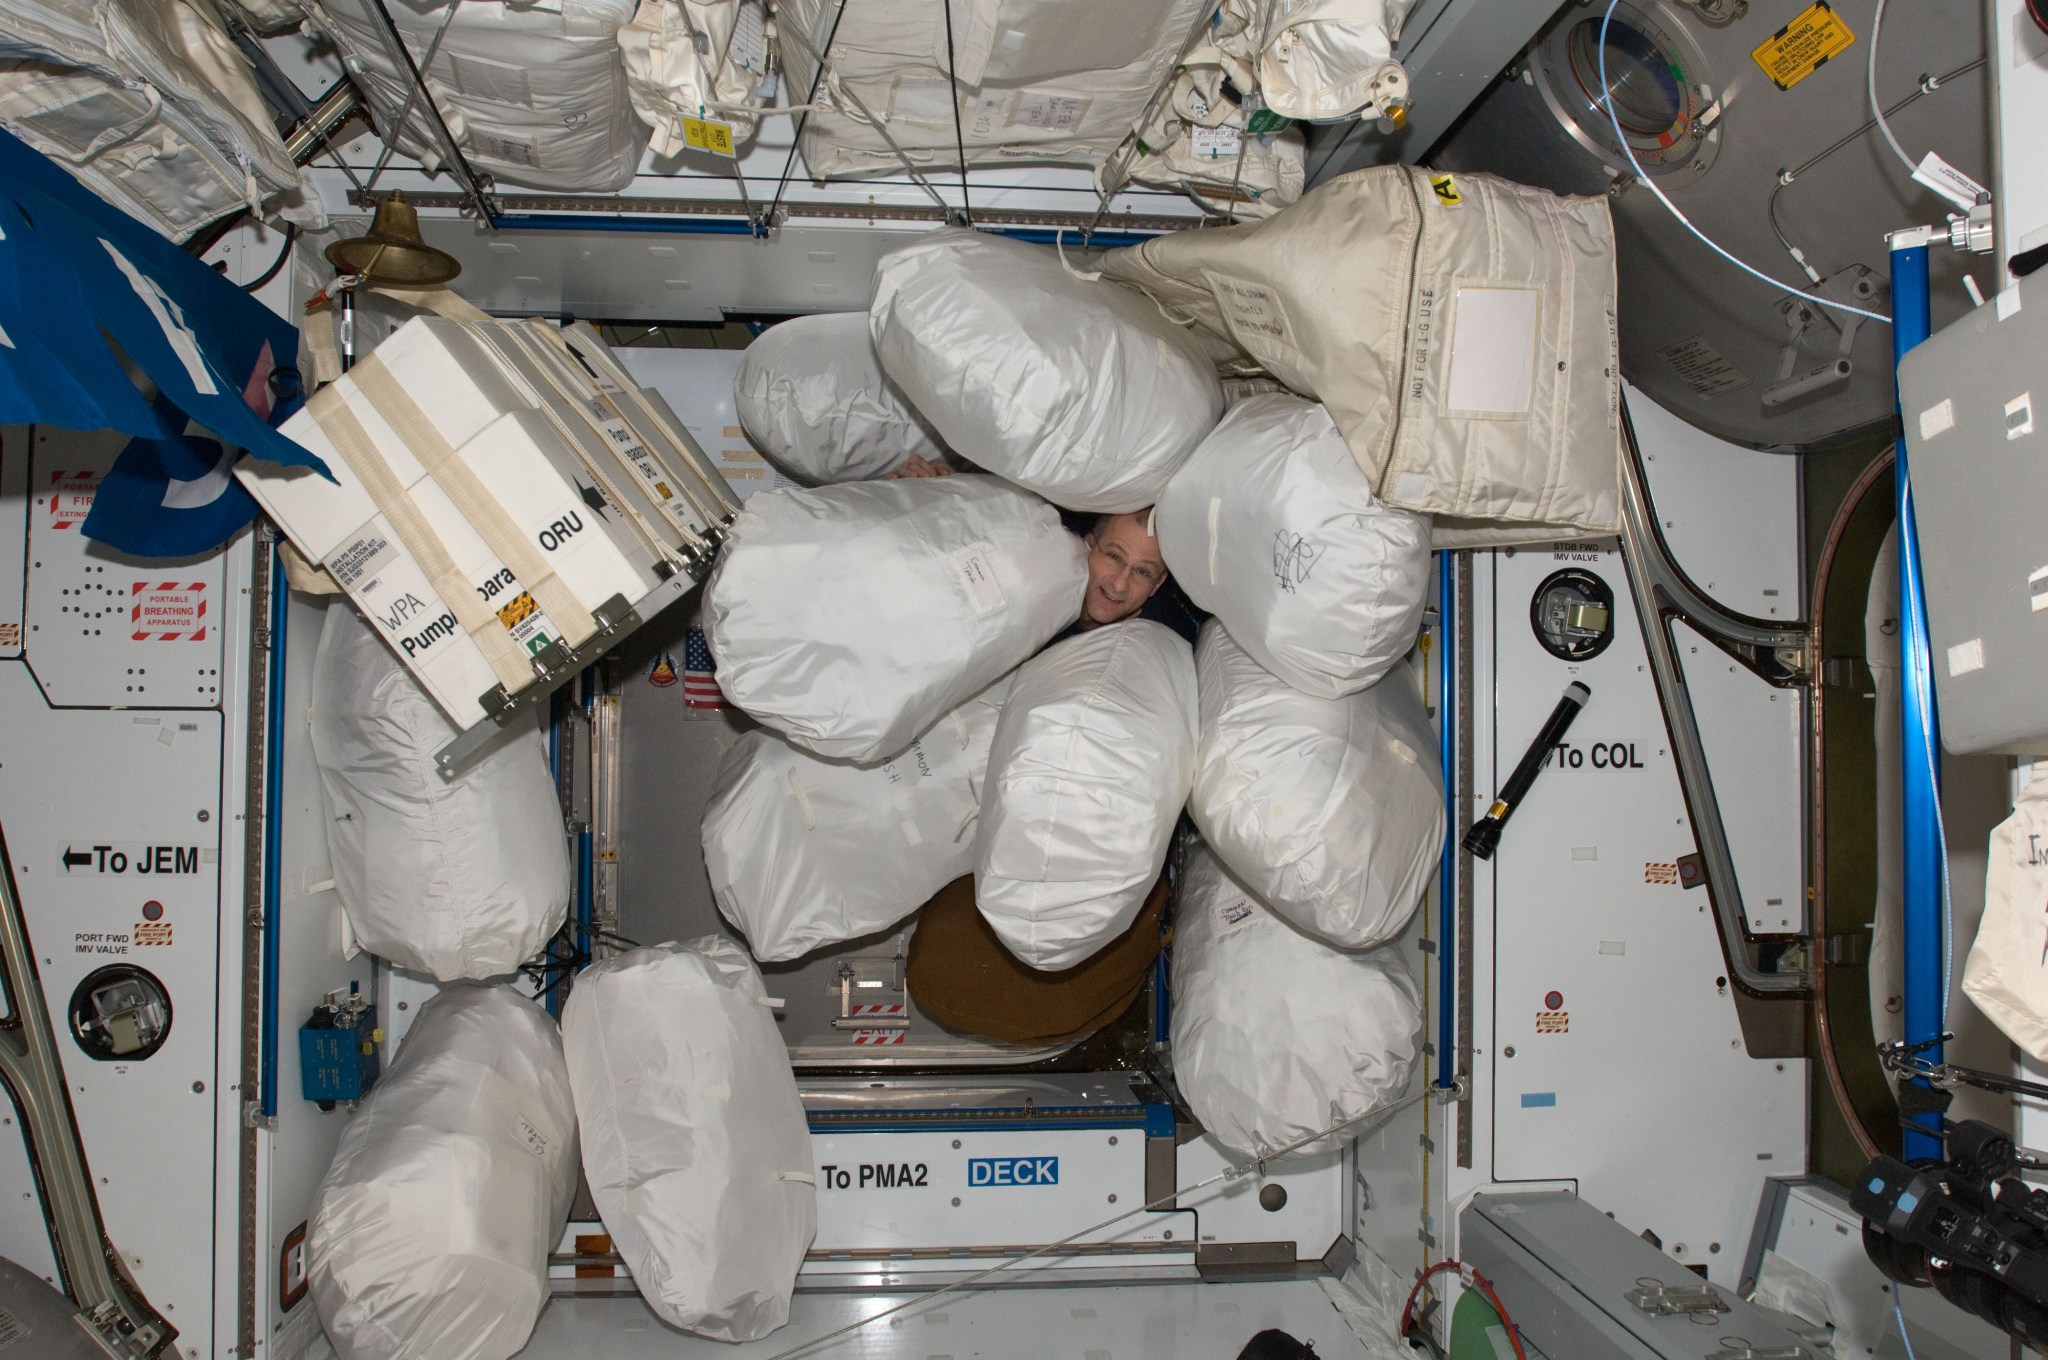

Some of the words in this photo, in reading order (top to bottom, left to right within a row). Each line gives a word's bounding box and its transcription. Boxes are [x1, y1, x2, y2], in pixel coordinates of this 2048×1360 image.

[1775, 23, 1814, 55] WARNING
[1421, 290, 1434, 316] USE
[1417, 348, 1426, 372] FOR
[1412, 378, 1424, 398] NOT
[639, 461, 658, 479] ORU
[74, 497, 93, 505] FIR
[538, 509, 584, 553] ORU
[334, 545, 369, 574] INSTALLATION
[367, 538, 377, 548] KIT
[1554, 543, 1578, 551] STDB
[1579, 543, 1599, 552] FWD
[1554, 553, 1570, 561] IMV
[1572, 553, 1598, 561] VALVE
[352, 568, 364, 579] 1001
[144, 607, 194, 615] BREATHING
[377, 592, 425, 631] WPA
[1556, 743, 1583, 768] To
[1592, 742, 1644, 768] COL
[93, 846, 127, 873] To
[137, 846, 198, 874] JEM
[97, 946, 128, 954] VALVE
[822, 1165, 851, 1189] To
[860, 1163, 927, 1188] PMA2
[972, 1160, 1055, 1184] DECK
